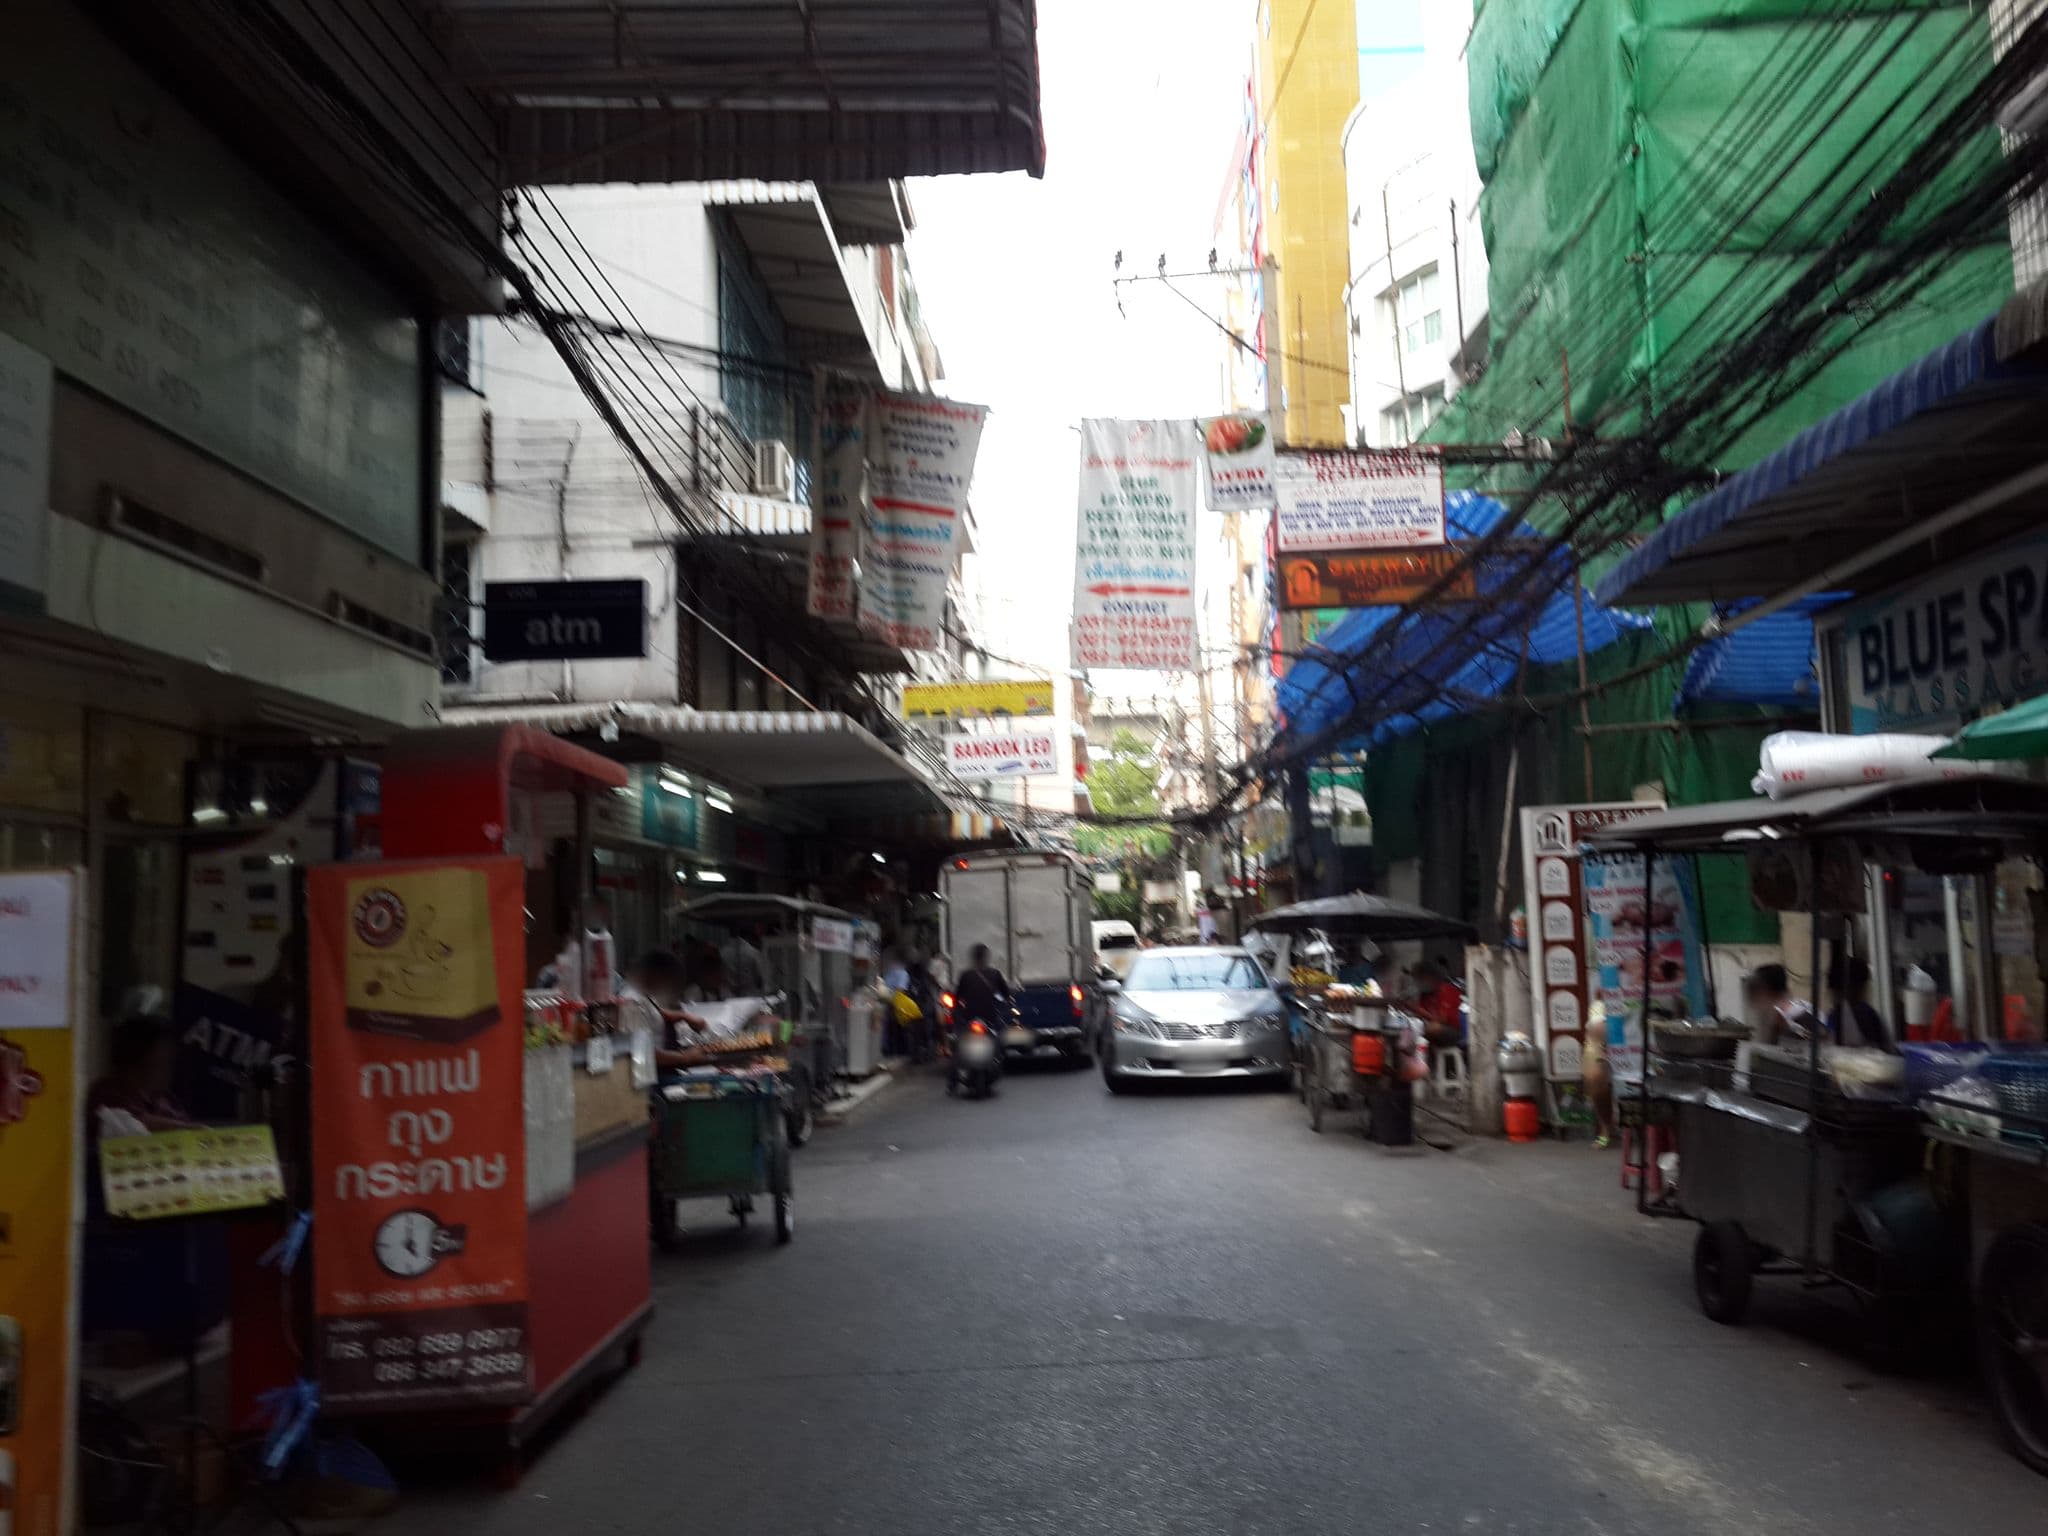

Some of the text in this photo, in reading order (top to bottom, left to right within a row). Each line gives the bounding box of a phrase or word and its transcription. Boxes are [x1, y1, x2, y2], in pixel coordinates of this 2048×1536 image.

[526, 612, 602, 646] atm
[1858, 564, 2048, 696] BLUE SP
[1874, 648, 2048, 729] MASSAG
[359, 1048, 481, 1100] กาแฟ
